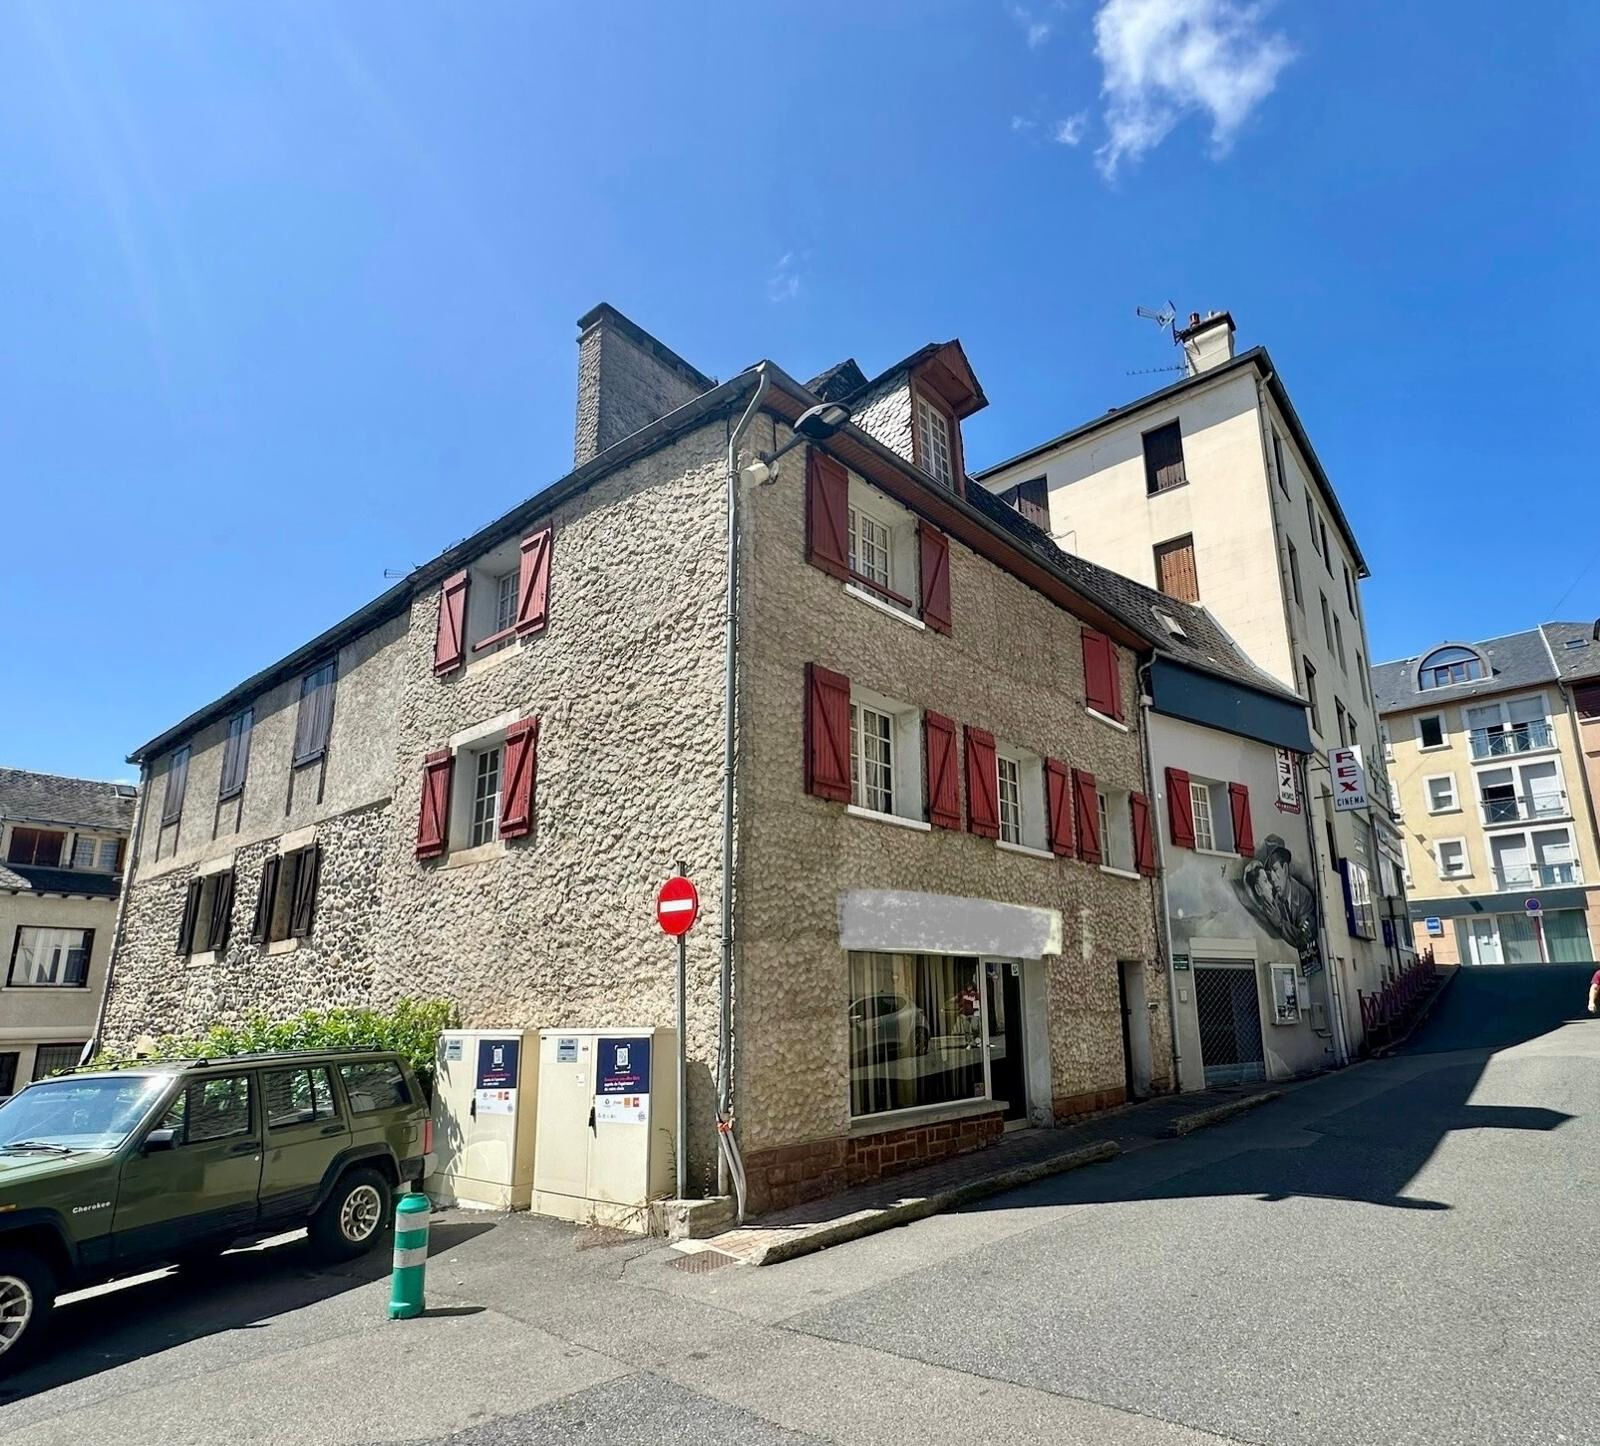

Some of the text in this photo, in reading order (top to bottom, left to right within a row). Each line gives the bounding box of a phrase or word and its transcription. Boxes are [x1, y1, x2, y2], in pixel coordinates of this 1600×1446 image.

[1336, 751, 1357, 793] REX
[1337, 796, 1364, 806] CINEMA
[72, 1201, 111, 1214] Cherokee
